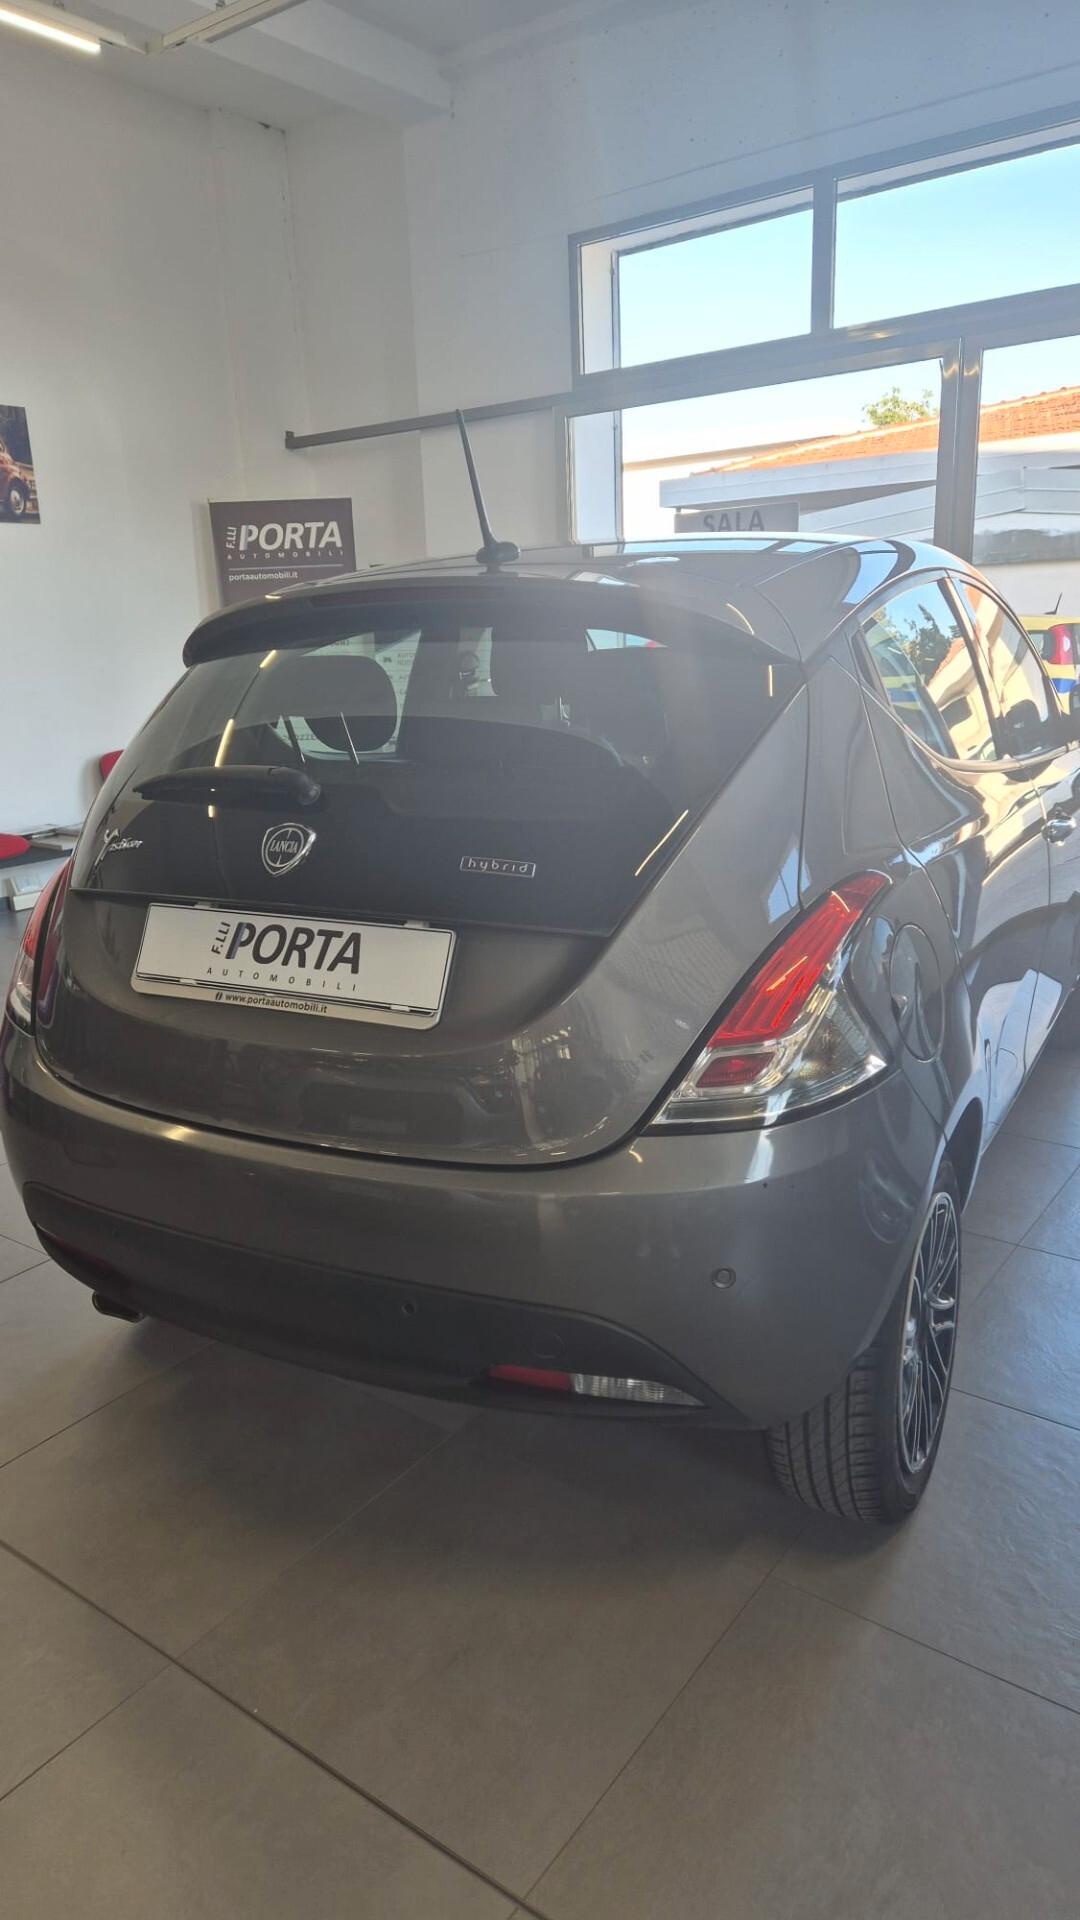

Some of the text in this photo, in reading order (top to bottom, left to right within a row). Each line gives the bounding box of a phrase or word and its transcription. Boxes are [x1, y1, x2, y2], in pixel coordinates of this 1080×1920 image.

[703, 510, 765, 532] SALA
[239, 521, 343, 551] PORTA
[227, 551, 344, 560] AUTOMOBILI
[228, 571, 298, 582] portaautomobili.it
[269, 840, 299, 853] LANCIA
[468, 858, 528, 872] hybrid
[211, 921, 361, 974] F.LLI PORTA
[206, 967, 357, 991] AUTOMOBILI
[225, 993, 328, 1014] www.portaautomobili.it
